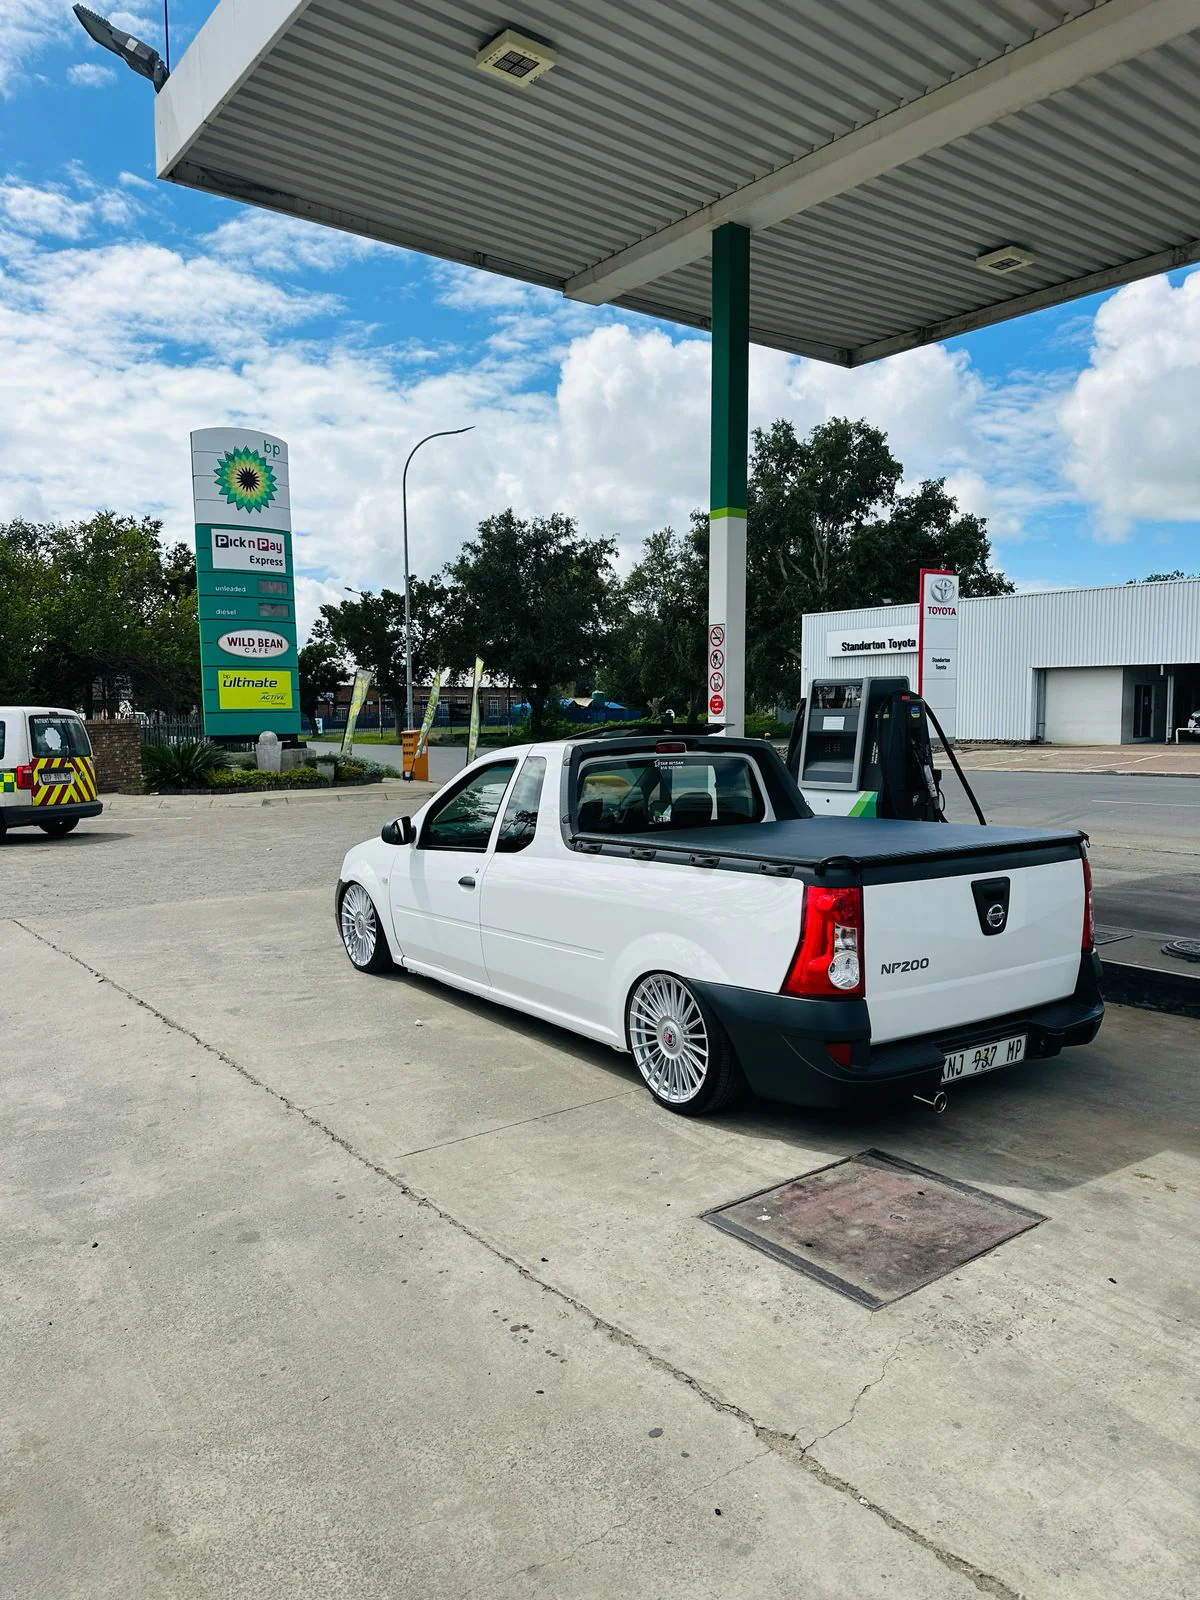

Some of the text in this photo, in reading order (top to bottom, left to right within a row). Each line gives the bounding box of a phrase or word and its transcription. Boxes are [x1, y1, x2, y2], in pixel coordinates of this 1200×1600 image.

[263, 440, 280, 457] bp
[215, 534, 246, 548] Pick
[257, 538, 282, 554] Pay
[249, 555, 283, 566] Express
[927, 606, 957, 616] TOYOTA
[227, 637, 283, 649] WILD BEAN
[841, 638, 917, 652] Standerton Toyota
[223, 677, 278, 688] ultimate
[881, 958, 929, 975] NP200
[974, 1046, 998, 1070] 937
[1006, 1039, 1022, 1062] MP
